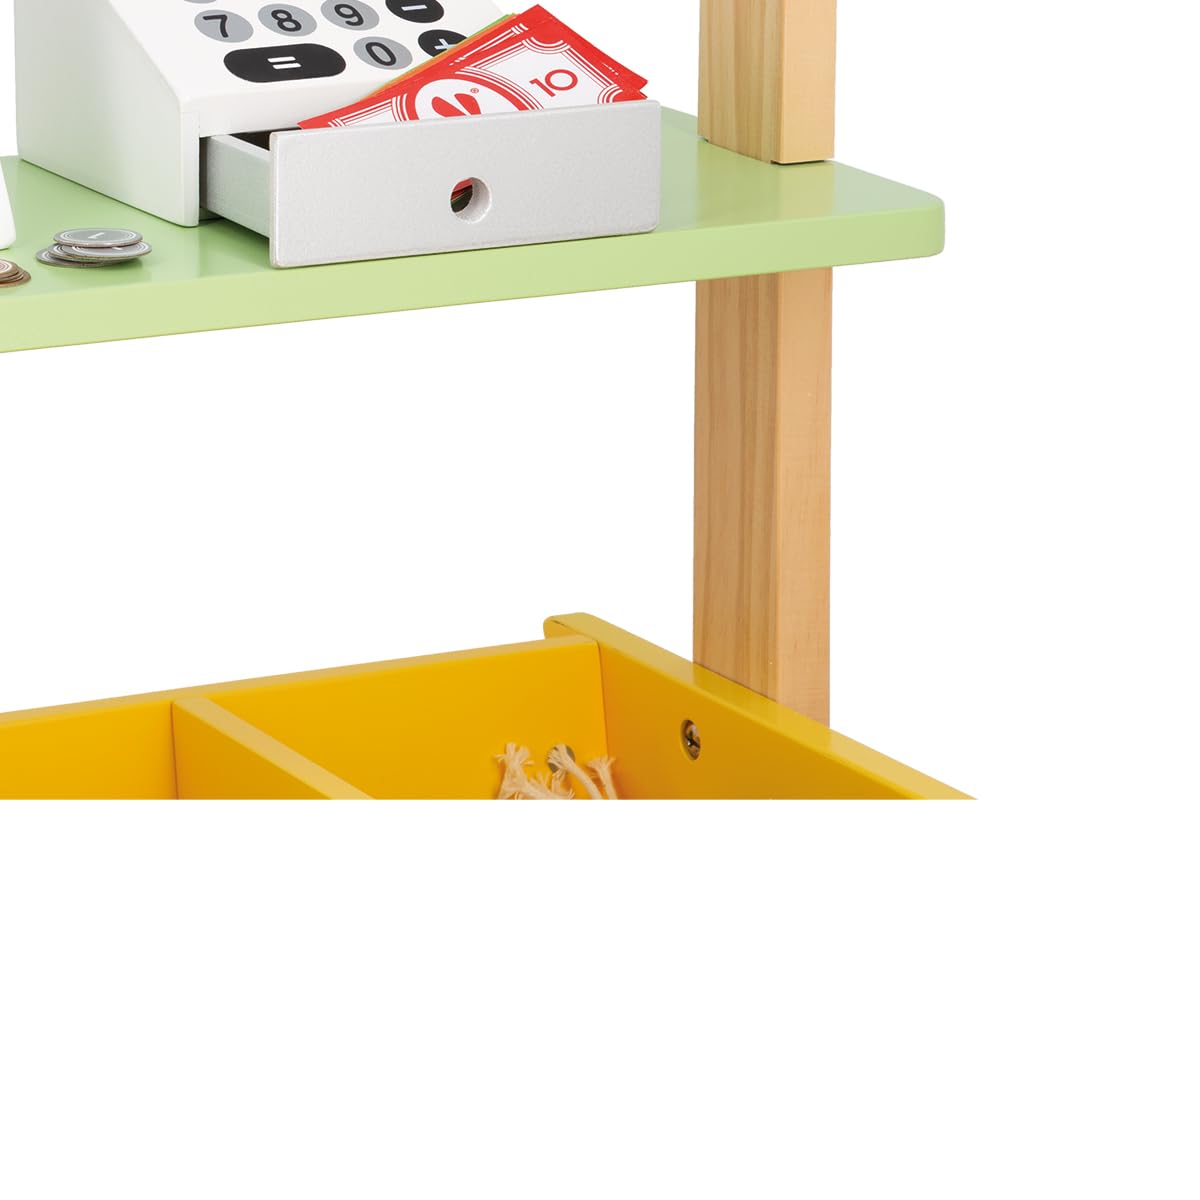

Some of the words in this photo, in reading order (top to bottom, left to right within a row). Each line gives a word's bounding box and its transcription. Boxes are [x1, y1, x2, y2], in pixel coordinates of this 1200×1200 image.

[202, 14, 229, 38] 7
[271, 9, 302, 32] 8
[334, 3, 364, 27] 9
[365, 41, 397, 66] 0
[529, 68, 578, 98] 10
